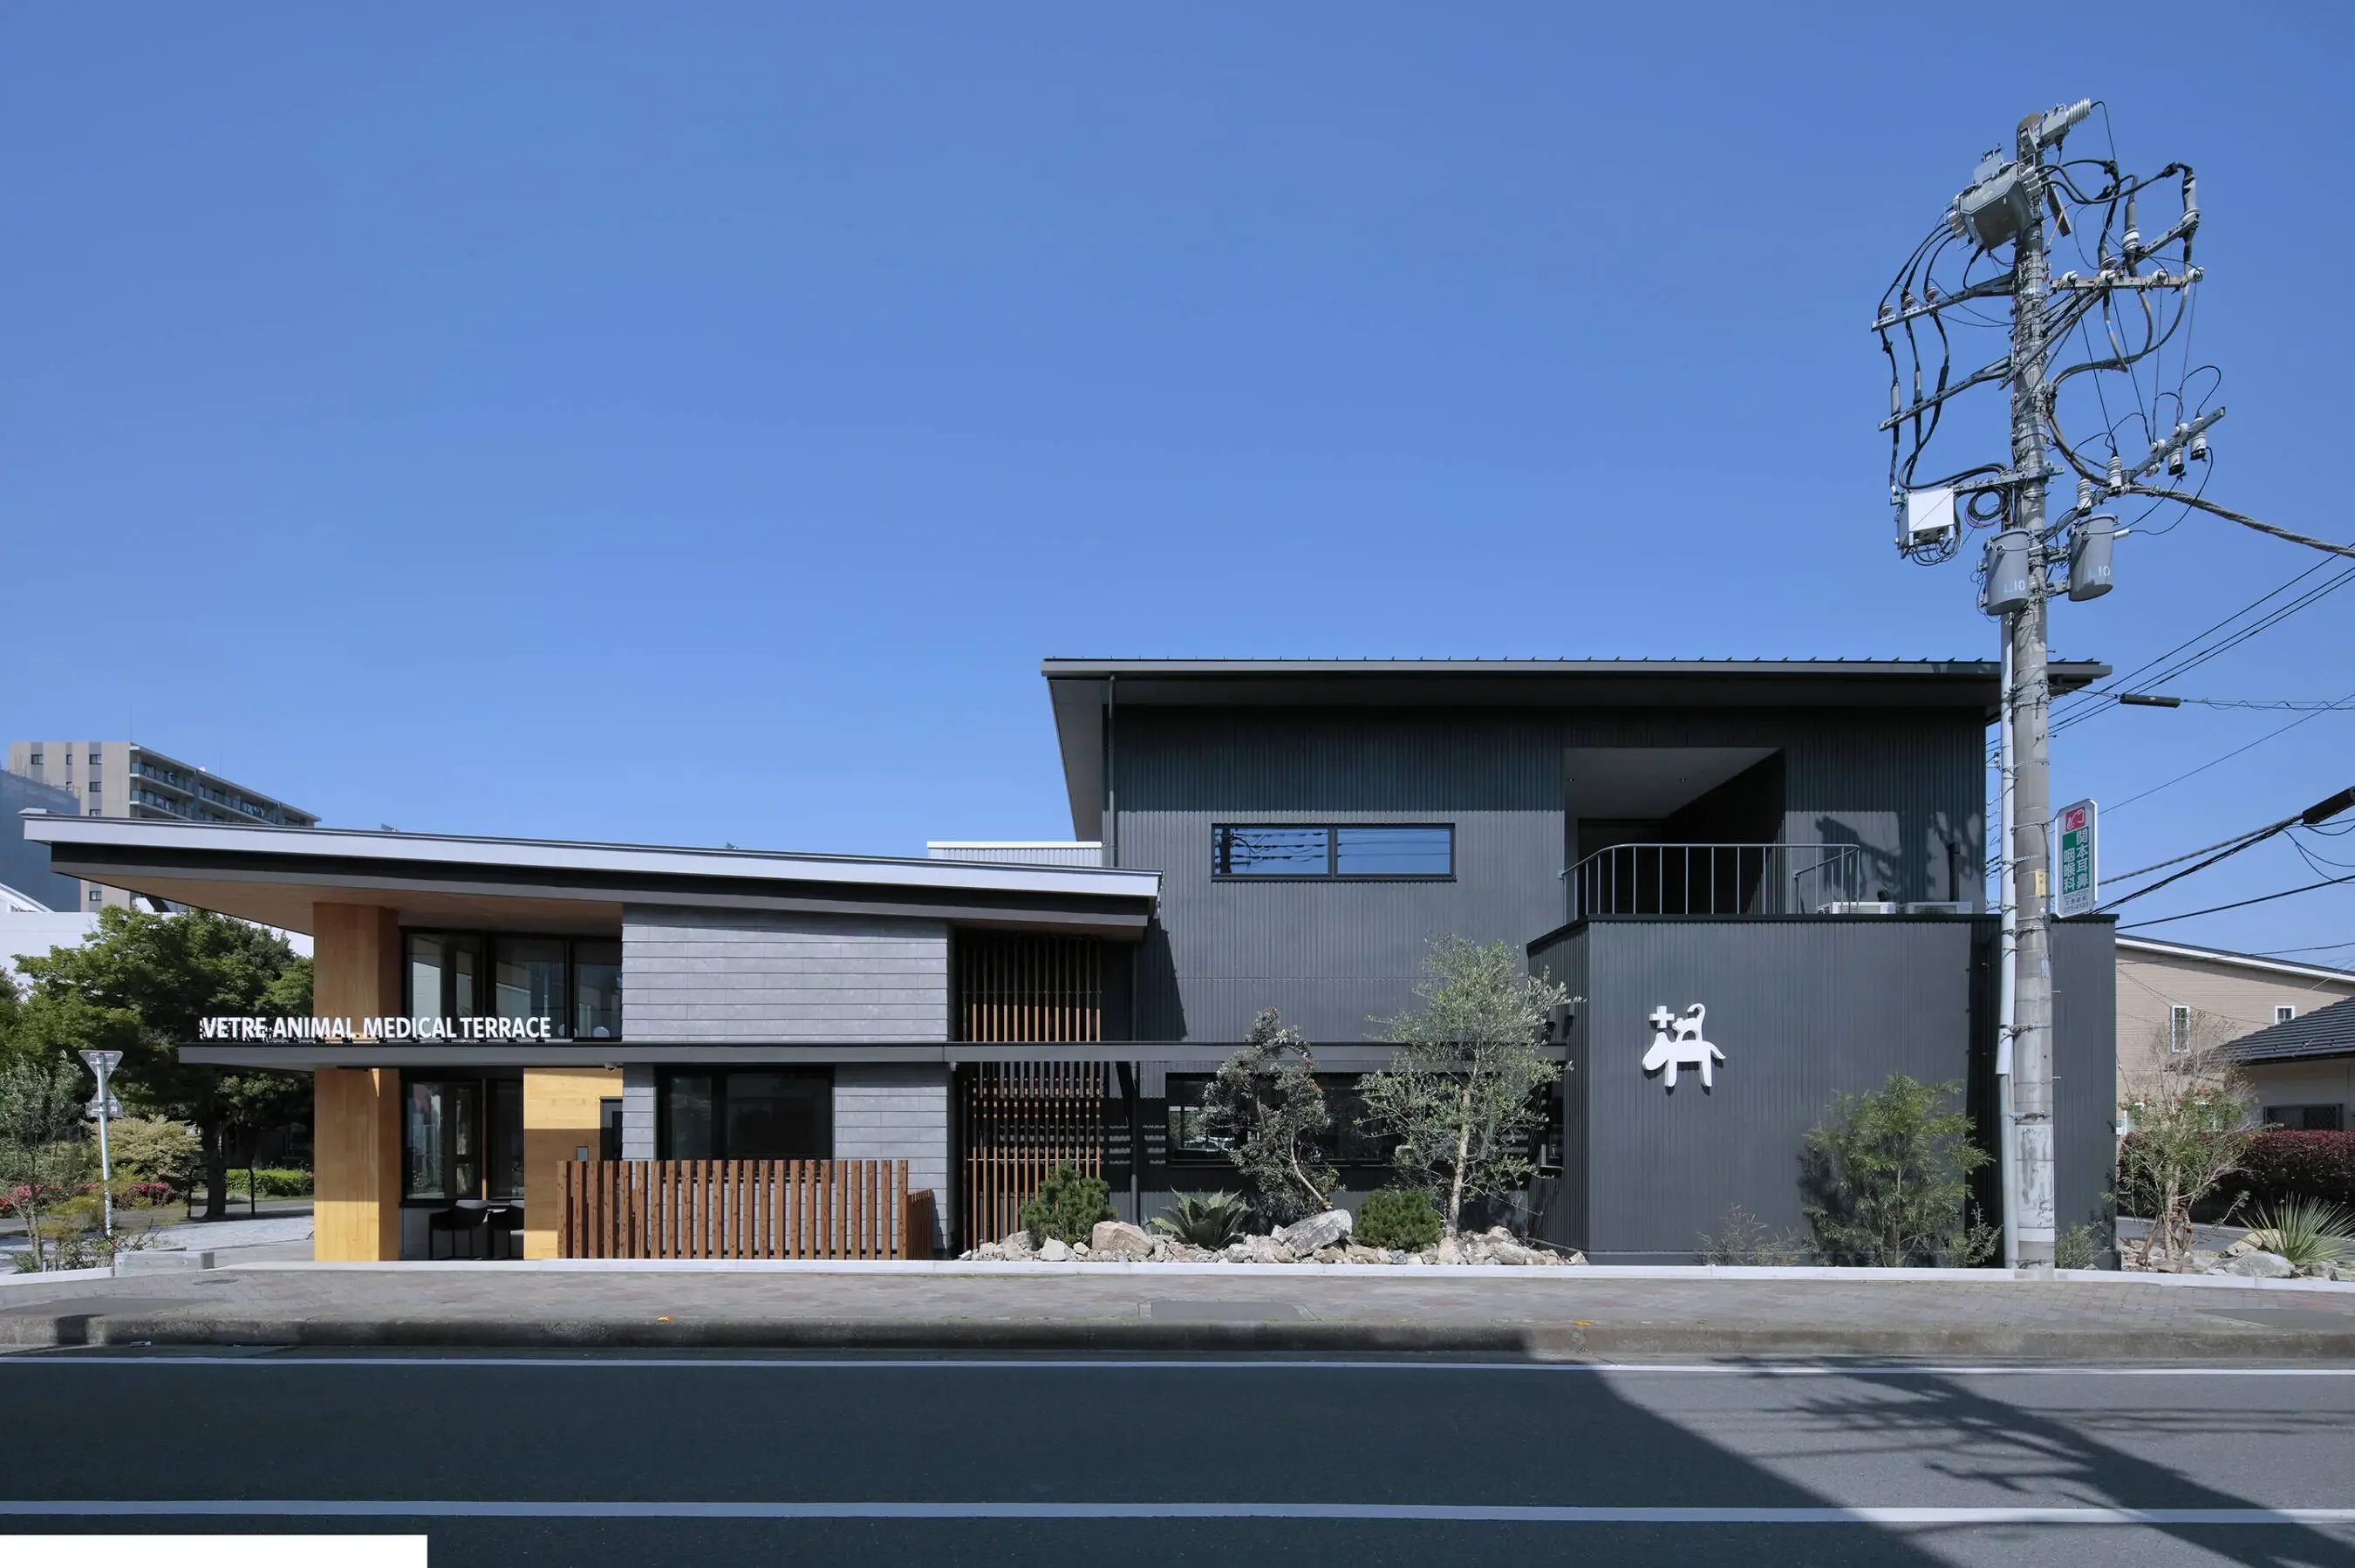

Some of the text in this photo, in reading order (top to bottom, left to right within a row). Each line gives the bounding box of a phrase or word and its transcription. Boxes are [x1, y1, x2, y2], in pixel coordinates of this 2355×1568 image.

[201, 1017, 551, 1039] VETRE ANIMAL MEDICAL TERRACE
